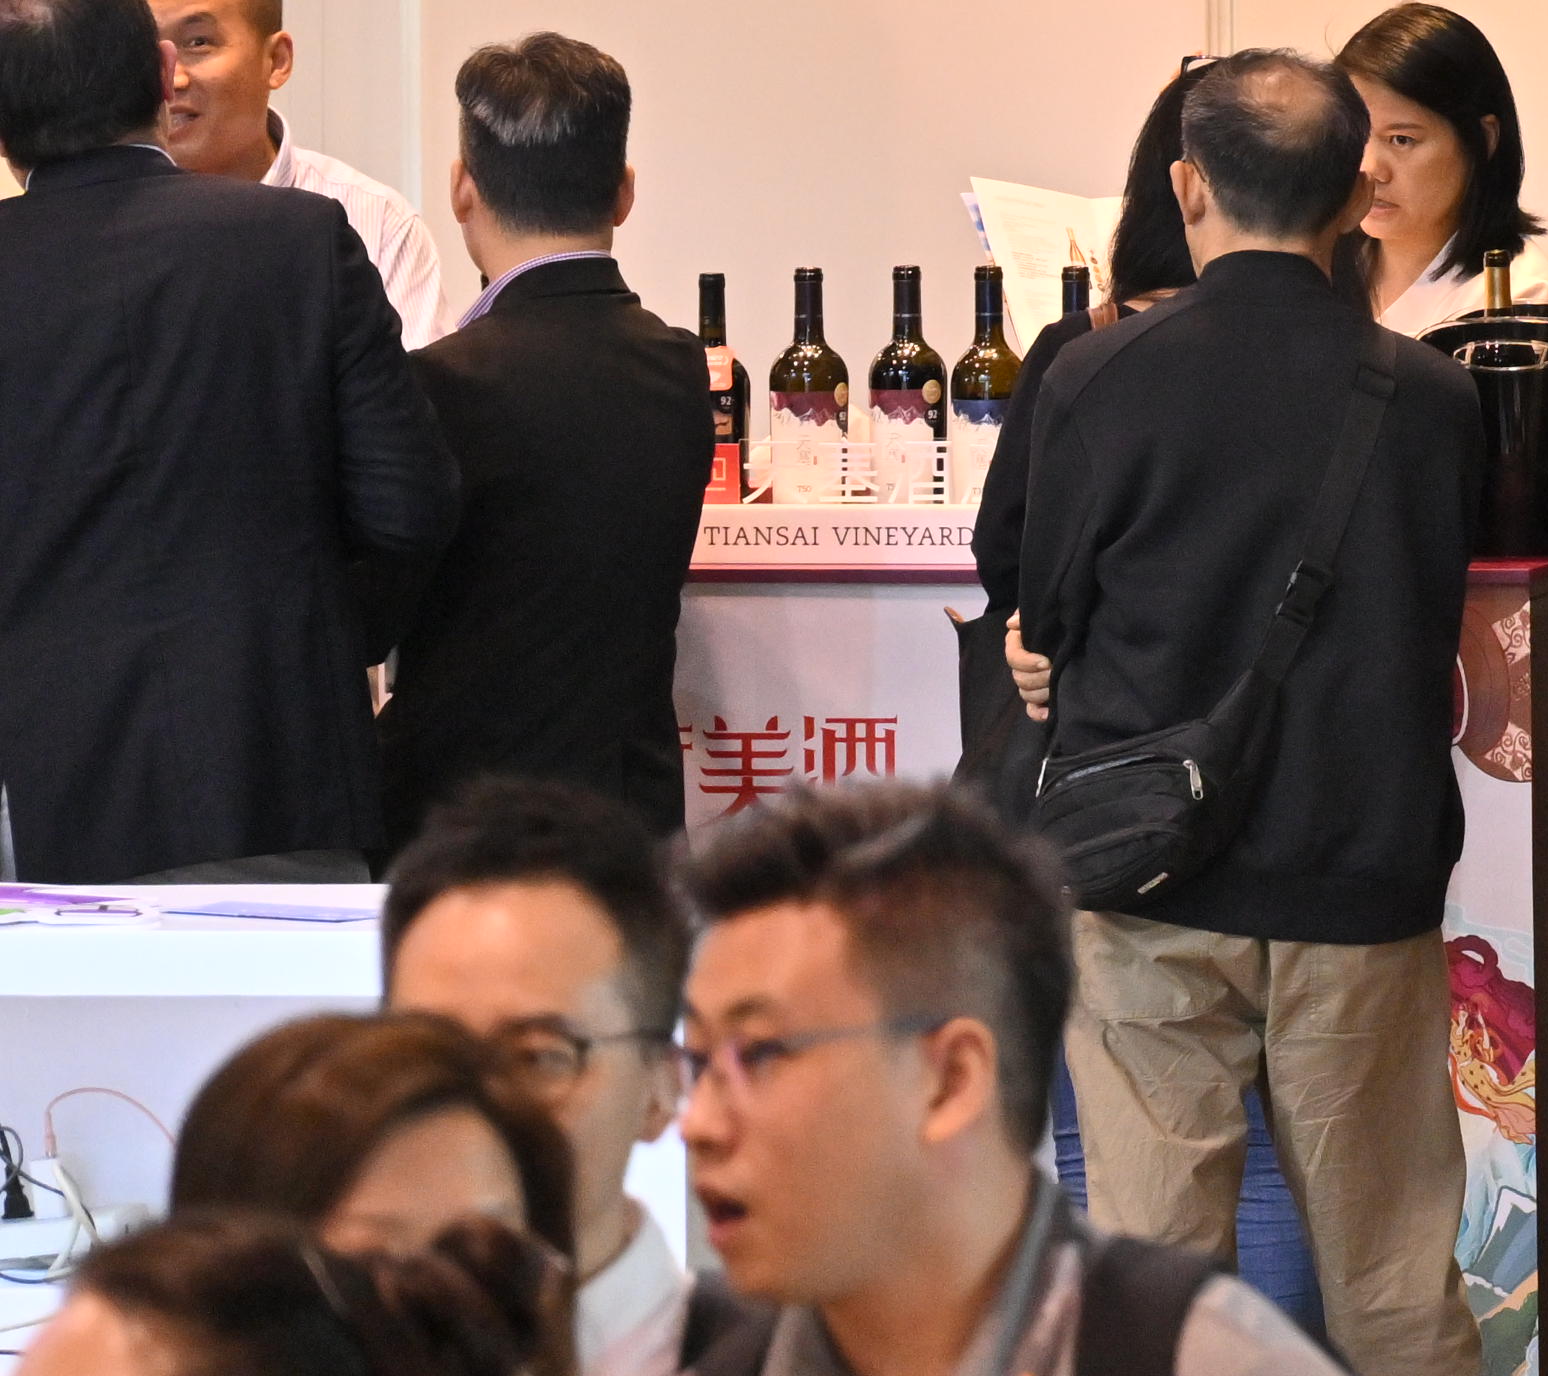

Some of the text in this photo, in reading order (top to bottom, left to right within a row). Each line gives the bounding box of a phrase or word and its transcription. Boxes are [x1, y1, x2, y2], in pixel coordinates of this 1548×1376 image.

[720, 395, 732, 406] 92
[927, 409, 938, 420] 92
[703, 526, 975, 547] TIANSAI VINEYARD
[679, 714, 898, 828] 美酒
